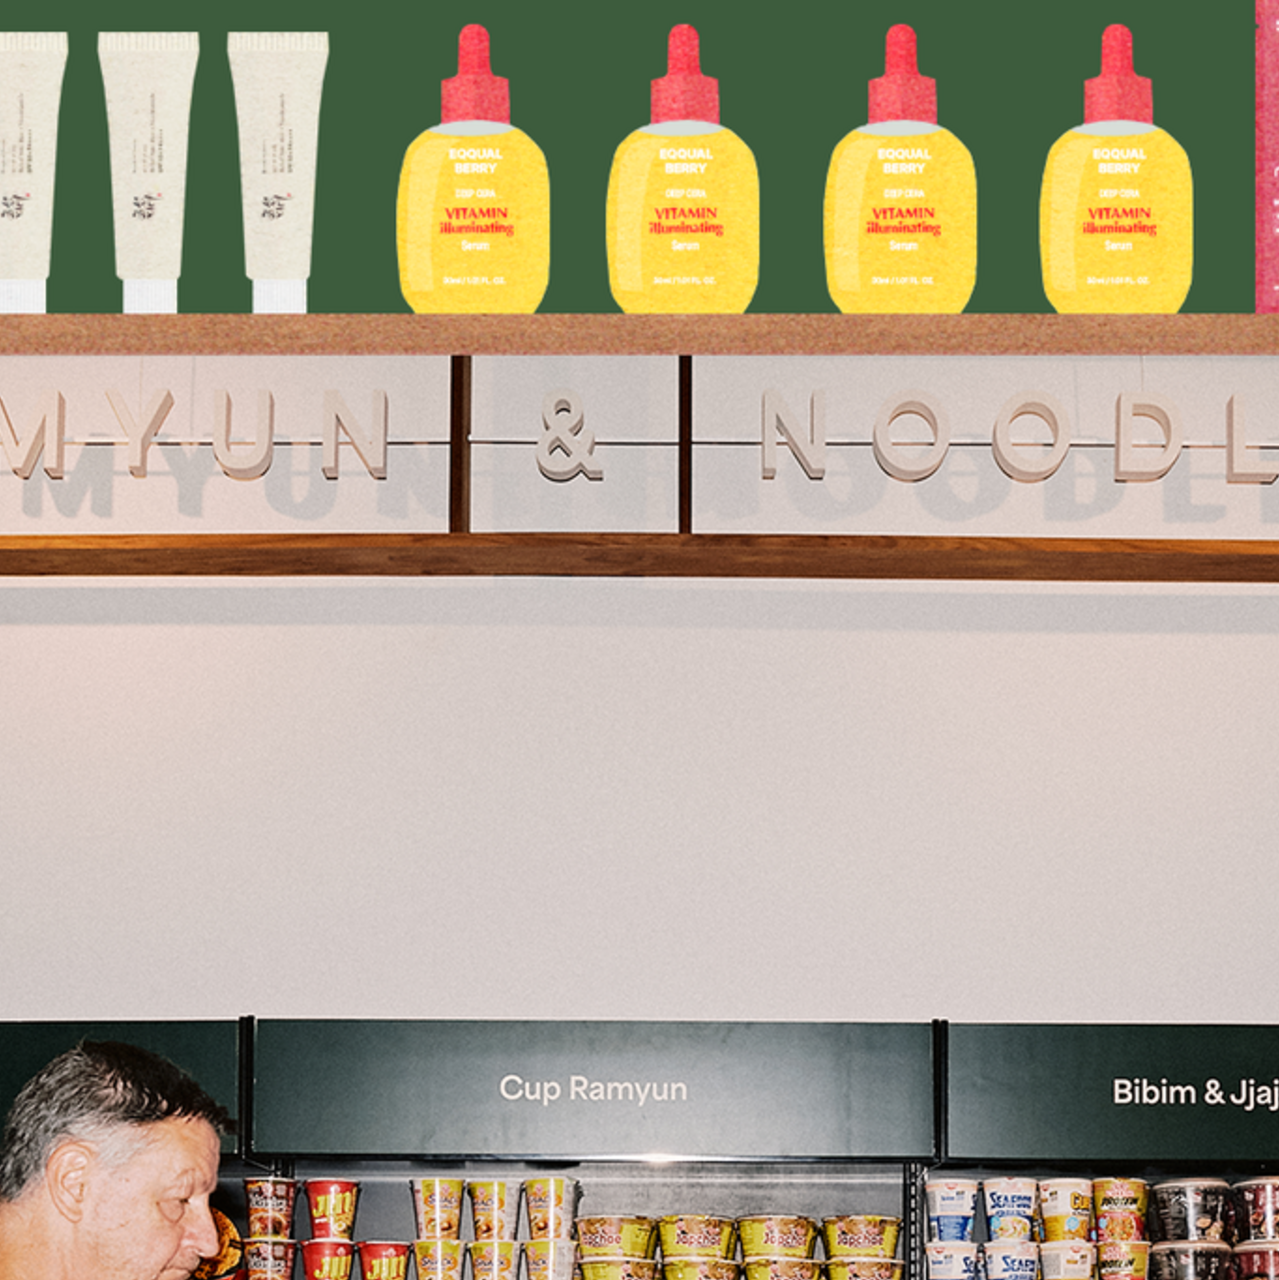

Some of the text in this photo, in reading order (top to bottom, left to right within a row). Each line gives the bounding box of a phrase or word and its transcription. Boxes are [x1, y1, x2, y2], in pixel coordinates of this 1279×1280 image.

[449, 148, 503, 160] EQQUAL
[659, 148, 713, 160] EQQUAL
[877, 148, 932, 160] EQQUAL
[1093, 148, 1147, 160] EQQUAL
[455, 163, 497, 174] BERRY
[665, 163, 708, 174] BERRY
[883, 163, 926, 174] BERRY
[1098, 163, 1141, 174] BERRY
[445, 207, 508, 219] VITAMIN
[654, 207, 717, 219] VITAMIN
[872, 207, 935, 219] VITAMIN
[1087, 207, 1151, 219] VITAMIN
[439, 221, 515, 237] illuminating
[649, 221, 724, 237] illuminating
[866, 221, 942, 237] illuminating
[1083, 221, 1157, 237] illuminating
[534, 398, 604, 481] &
[499, 1074, 688, 1107] Cup Ramyun
[1113, 1078, 1196, 1105] Bibim
[1204, 1079, 1226, 1105] &
